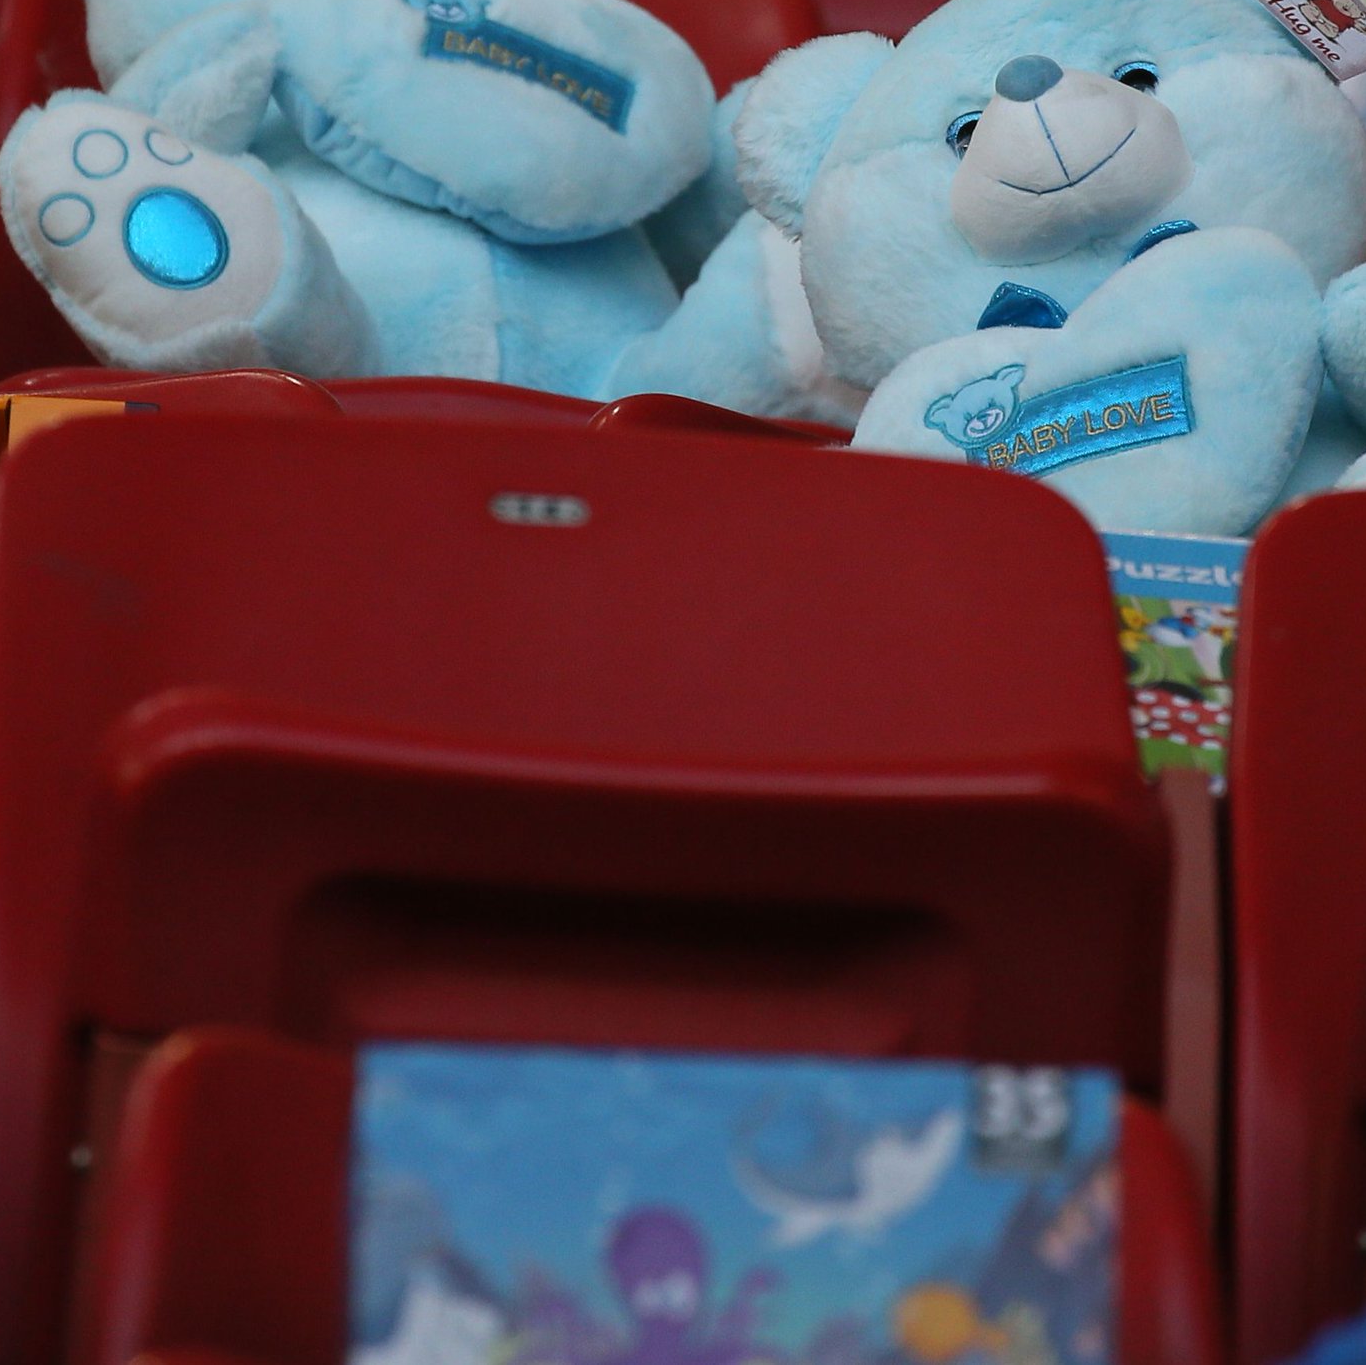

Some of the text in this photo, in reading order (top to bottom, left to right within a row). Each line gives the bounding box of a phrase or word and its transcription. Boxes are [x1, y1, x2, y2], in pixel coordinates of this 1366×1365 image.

[442, 29, 614, 117] BABY LOVE
[1311, 37, 1341, 63] me
[986, 392, 1175, 470] BABY LOVE
